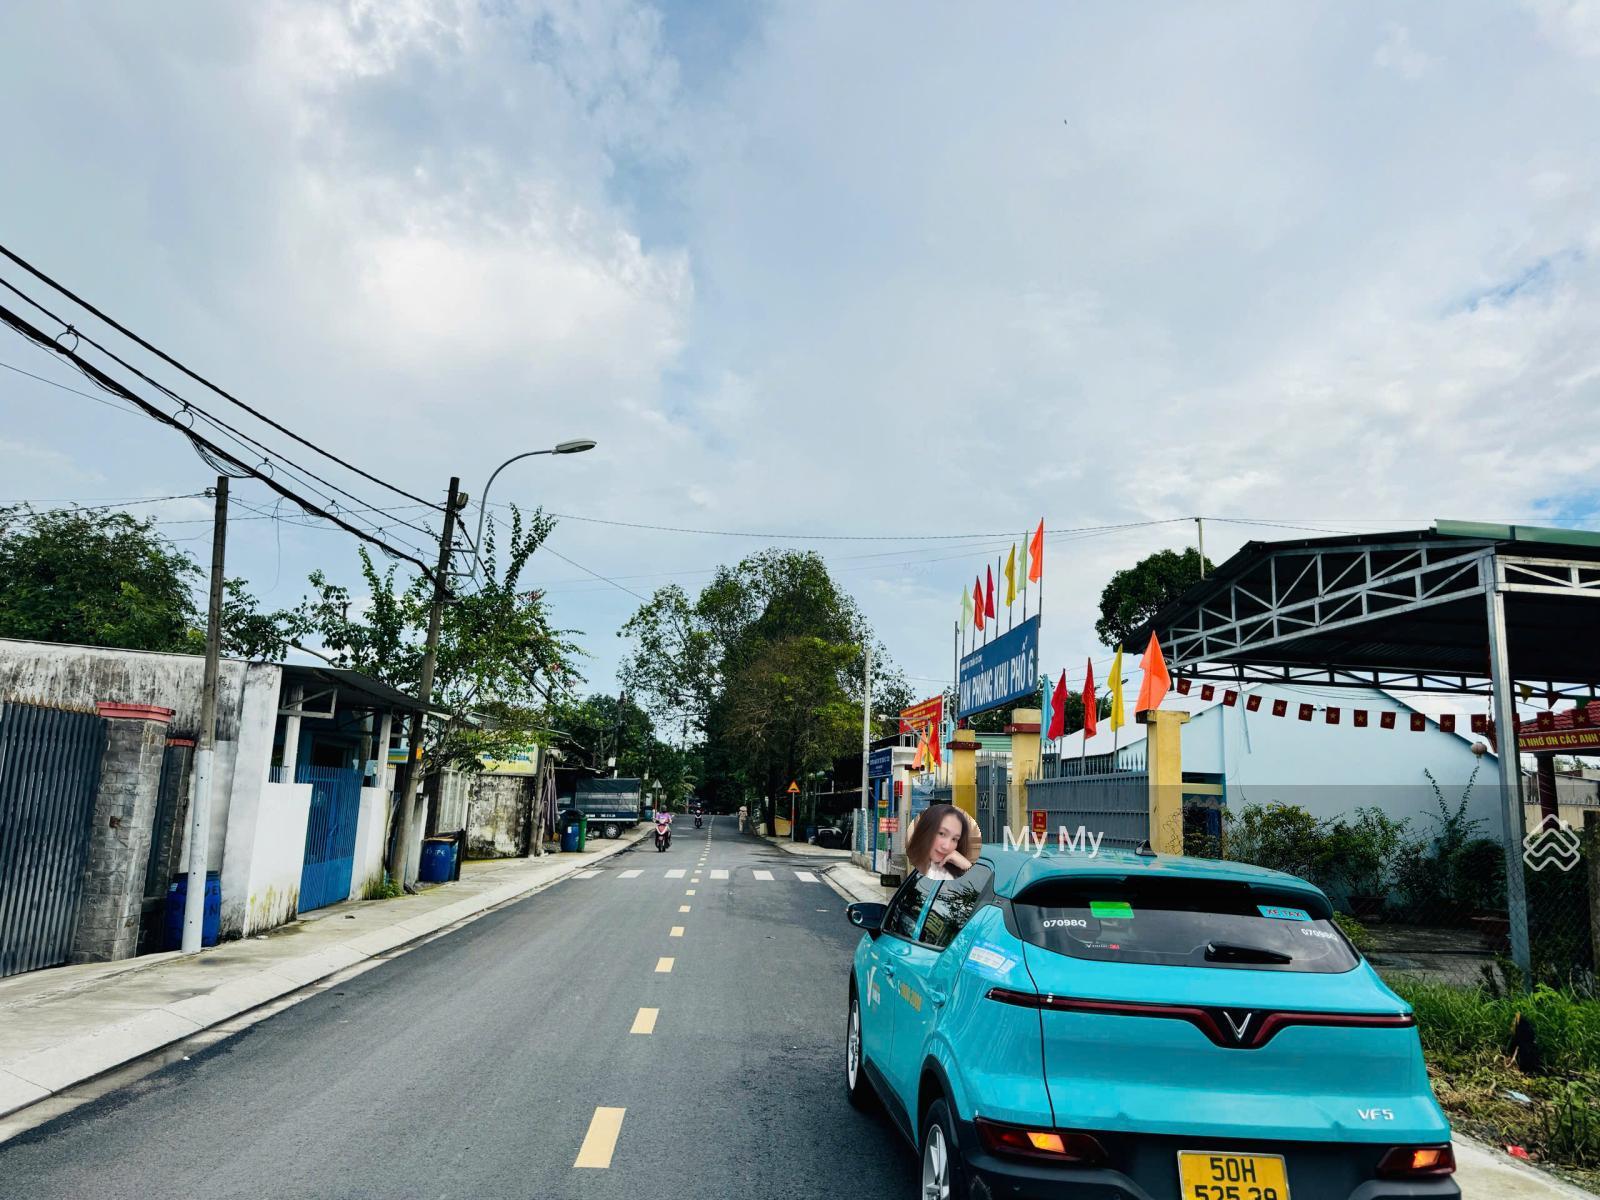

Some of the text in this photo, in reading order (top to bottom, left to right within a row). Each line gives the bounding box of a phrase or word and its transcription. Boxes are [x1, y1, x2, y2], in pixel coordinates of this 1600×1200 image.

[971, 664, 993, 708] PHÒNG
[994, 660, 1009, 700] KHU
[1010, 635, 1028, 694] PHỐ
[1028, 648, 1034, 687] 6
[1560, 732, 1578, 745] CÁC
[1580, 732, 1598, 743] ANH
[1043, 919, 1087, 928] 07098Q
[1210, 1157, 1257, 1183] 50H
